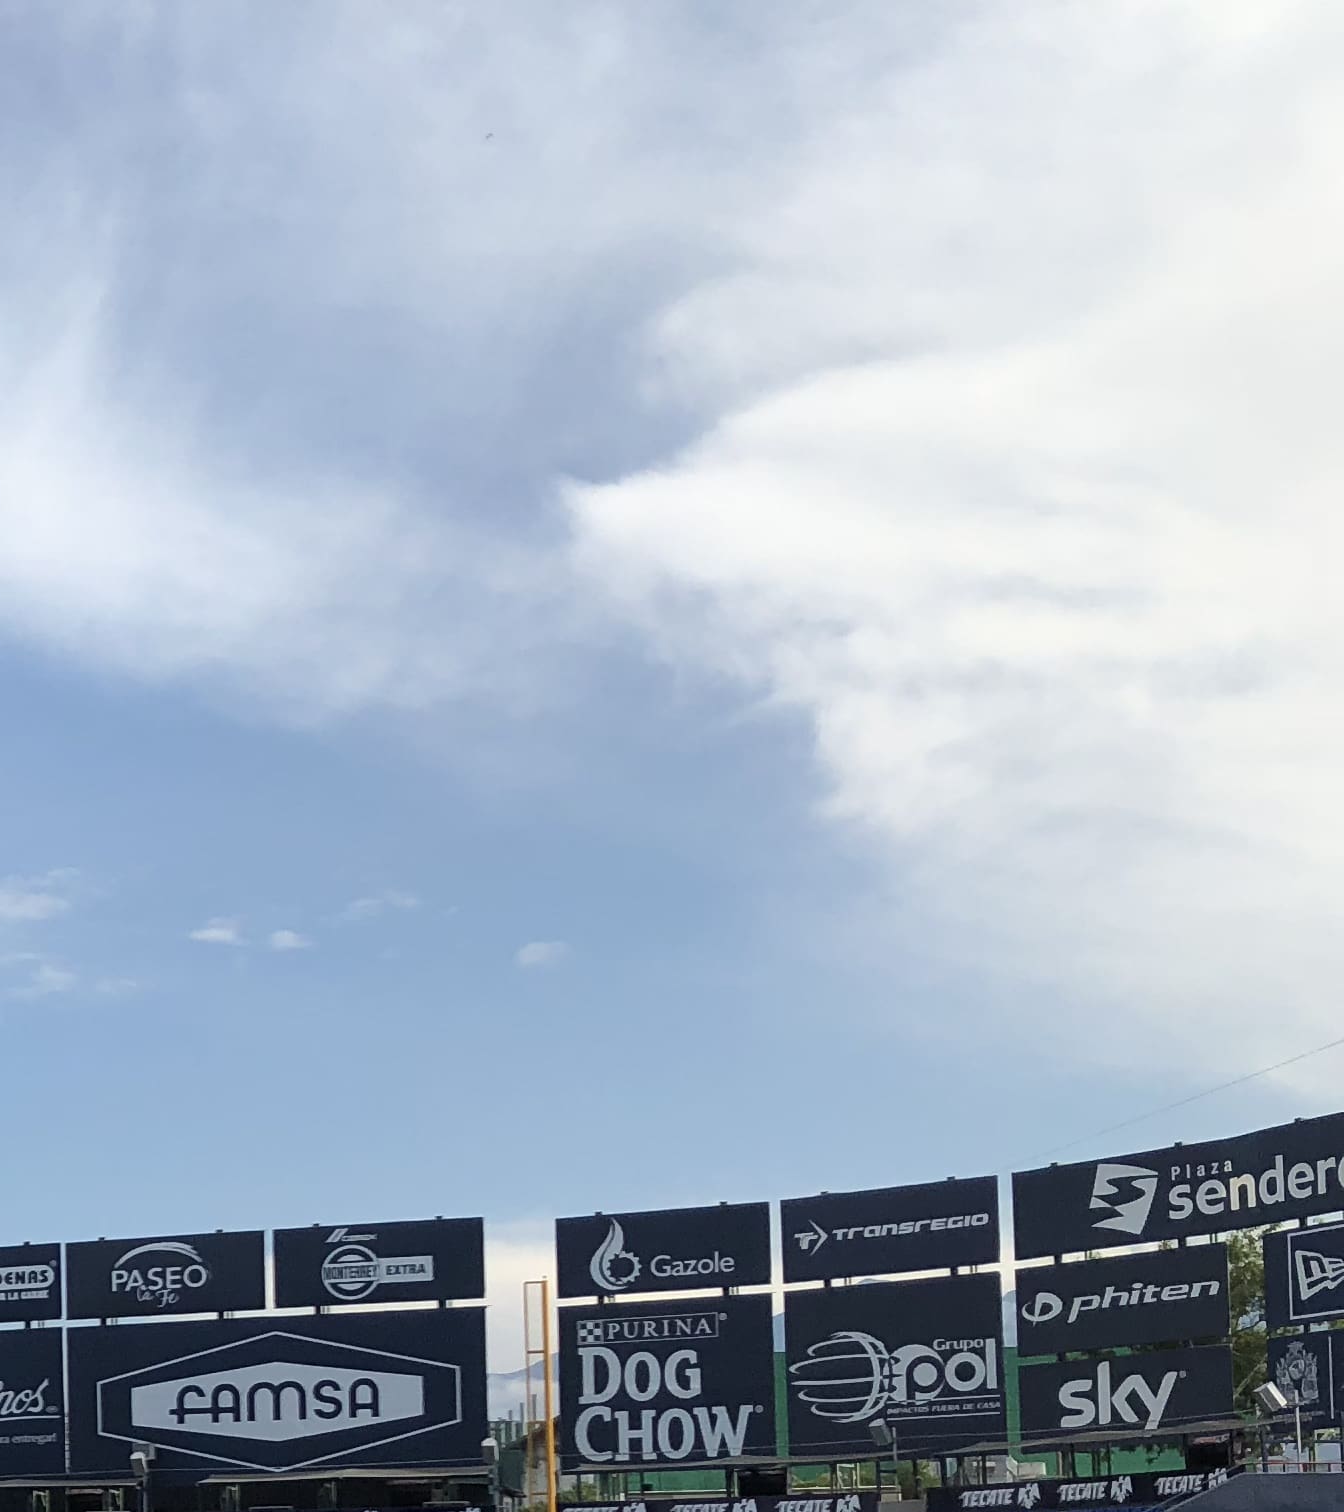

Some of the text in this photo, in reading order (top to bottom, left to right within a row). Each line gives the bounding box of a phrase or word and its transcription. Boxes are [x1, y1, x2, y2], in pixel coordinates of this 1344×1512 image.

[1171, 1160, 1233, 1181] Plaza
[1168, 1154, 1344, 1220] sender
[111, 1264, 207, 1292] PASEO
[385, 1263, 427, 1276] EXTRA
[650, 1251, 735, 1277] Gazole
[1067, 1280, 1221, 1323] phiten
[606, 1318, 713, 1340] PURINA
[933, 1338, 984, 1352] Grupo
[577, 1347, 702, 1405] DOG
[1059, 1361, 1179, 1430] sky
[574, 1405, 754, 1462] CHOW
